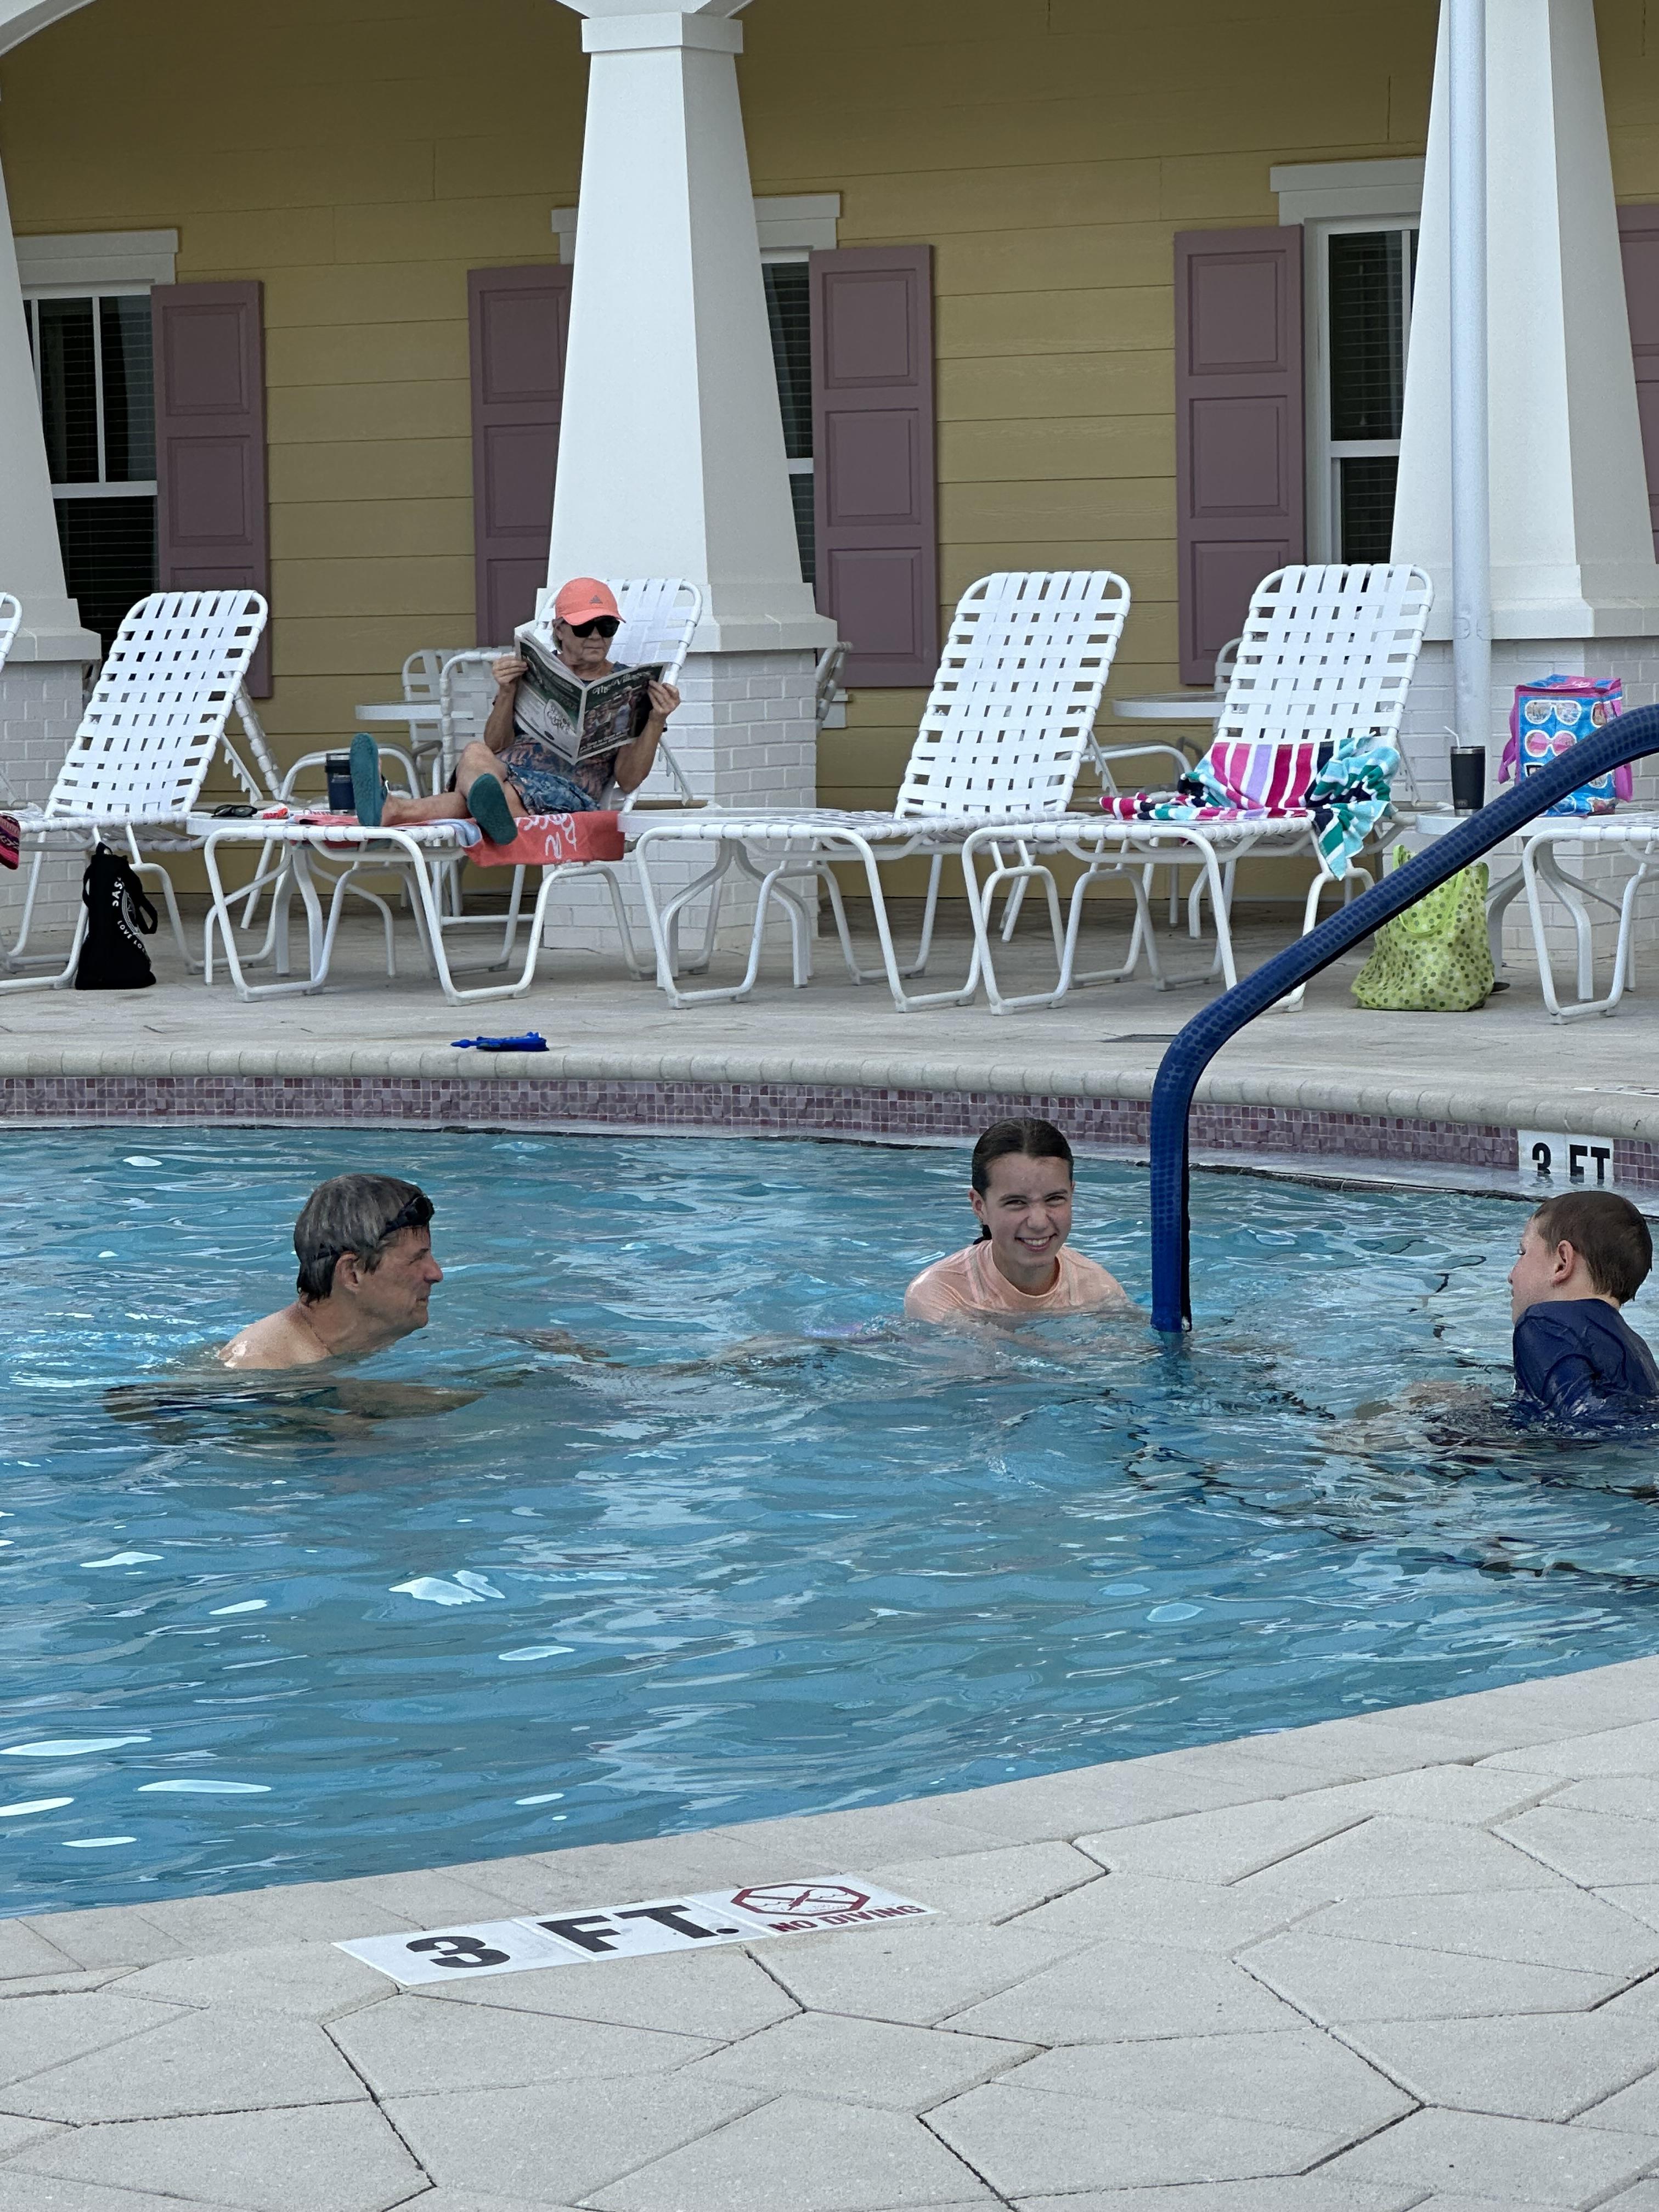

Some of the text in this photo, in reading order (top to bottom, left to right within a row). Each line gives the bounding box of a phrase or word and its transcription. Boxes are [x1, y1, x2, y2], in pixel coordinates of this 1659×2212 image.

[117, 920, 133, 939] LOVE
[1532, 1142, 1611, 1180] 3 FT
[767, 1919, 818, 1932] NO
[818, 1905, 928, 1926] DIVING
[406, 1904, 740, 1968] 3 FT.
